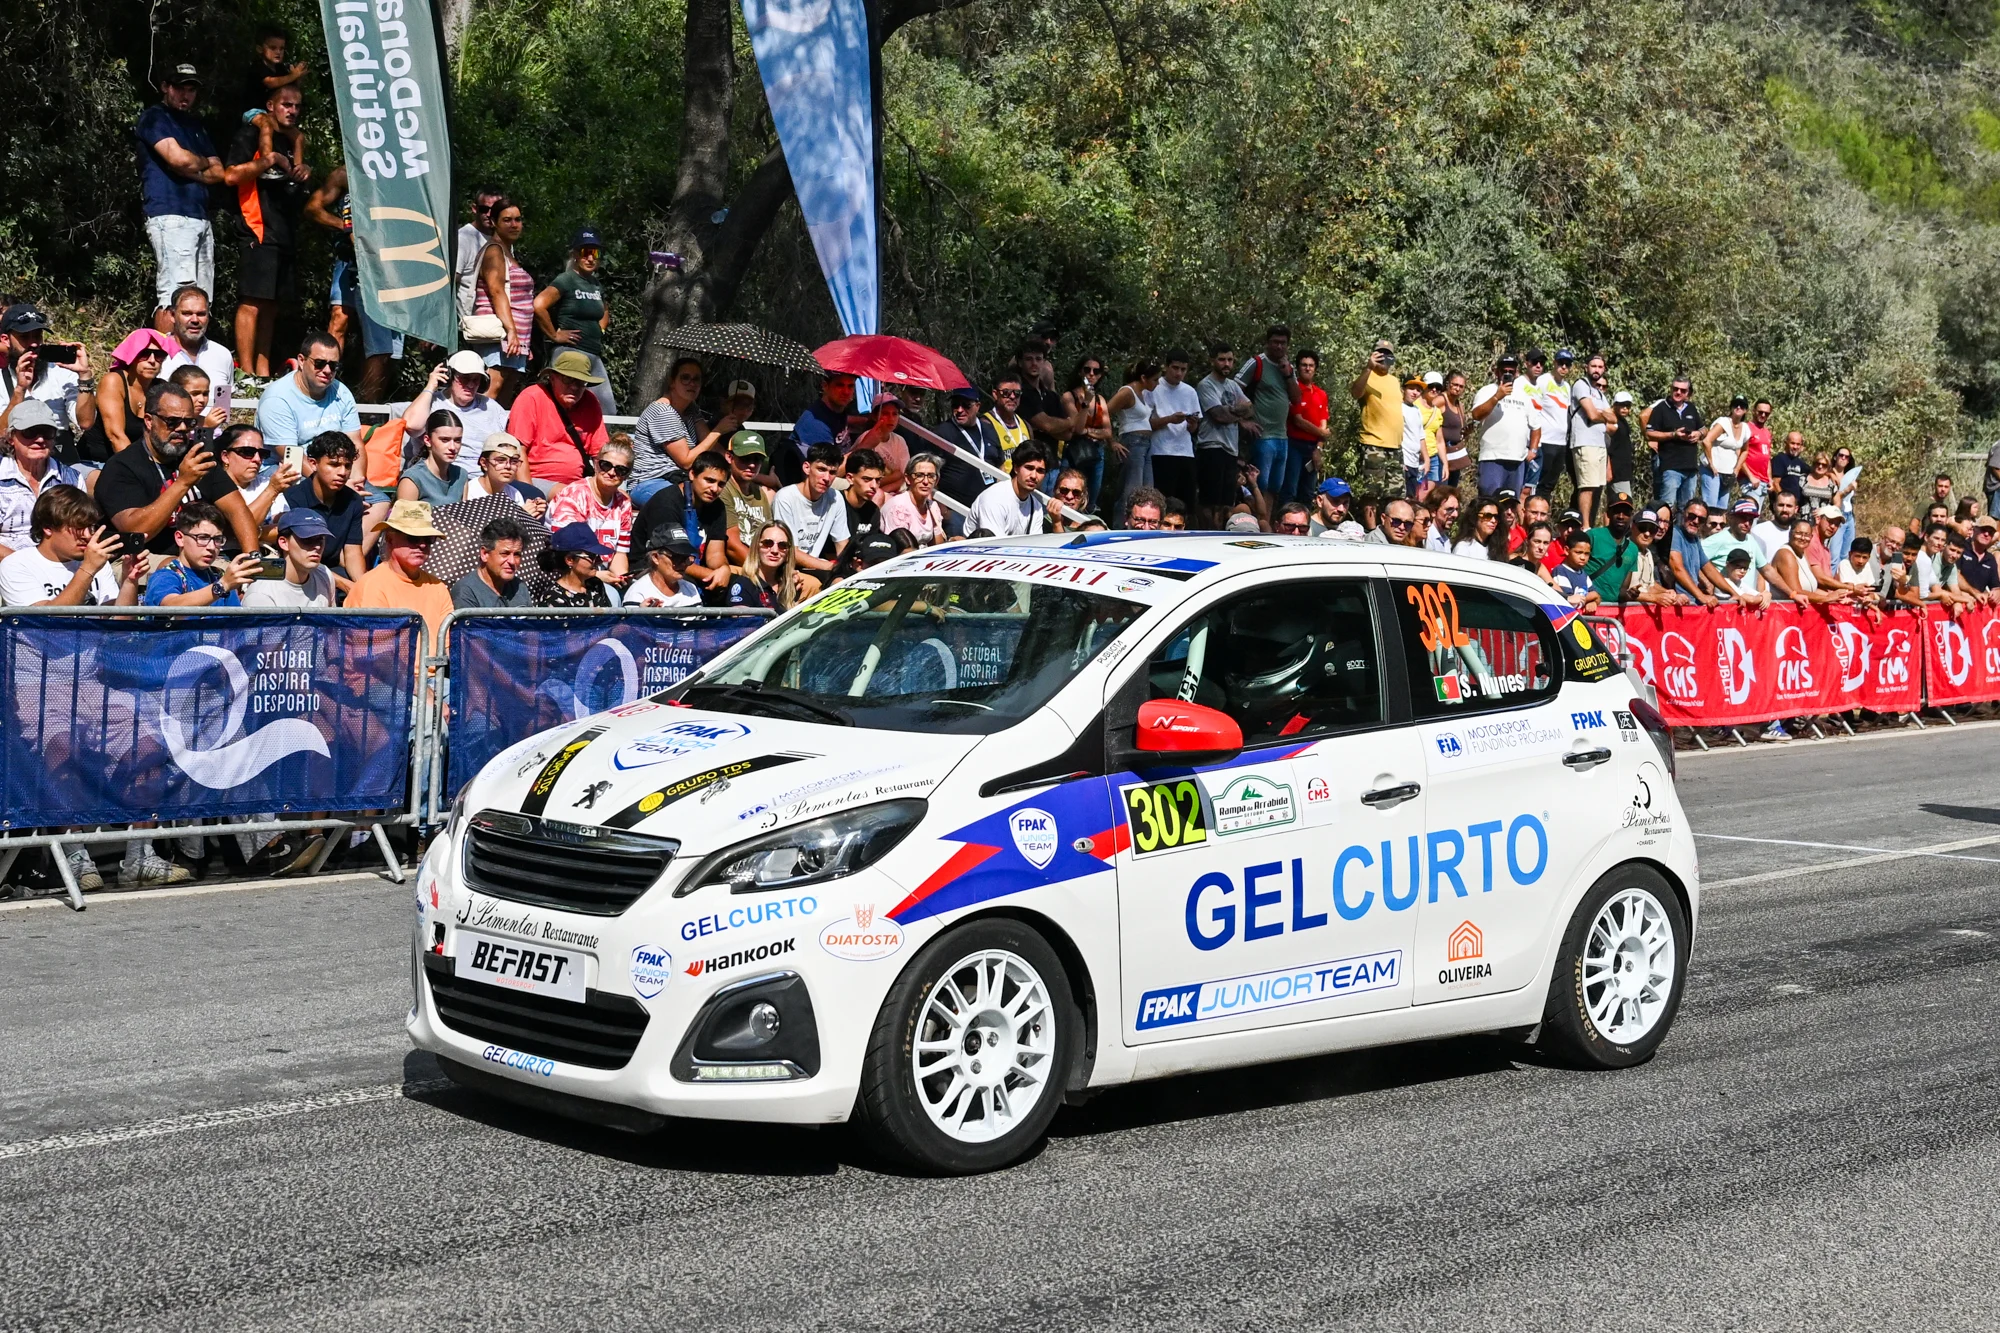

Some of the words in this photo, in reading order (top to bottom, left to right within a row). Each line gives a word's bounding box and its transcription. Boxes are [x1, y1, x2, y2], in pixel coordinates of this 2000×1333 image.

[802, 588, 873, 614] 302
[1407, 582, 1470, 652] 302
[257, 644, 314, 669] SETÚBAL
[645, 642, 693, 665] SETÚBAL
[962, 642, 1002, 662] SETÚBAL
[960, 664, 998, 679] INSPIRA
[1777, 660, 1813, 691] CMS
[254, 672, 311, 692] INSPIRA
[1461, 679, 1477, 699] S.
[1480, 673, 1526, 696] Nunes
[1664, 665, 1699, 699] CMS
[254, 694, 321, 714] DESPORTO
[1468, 719, 1532, 740] MOTORSPORT
[1571, 710, 1607, 731] FPAK
[662, 724, 738, 740] FPAK
[1472, 735, 1517, 754] FUNDING
[1519, 729, 1564, 746] PROGRAM
[627, 742, 692, 757] TEAM
[666, 771, 719, 796] GRUPO
[720, 761, 752, 775] TDS
[875, 778, 935, 797] Restaurante
[1308, 788, 1329, 801] CMS
[1129, 781, 1206, 852] 302
[1219, 806, 1246, 817] Rampa
[1254, 797, 1288, 810] Arrabida
[1018, 818, 1047, 831] FPAK
[1622, 806, 1671, 829] Pimentas
[1018, 834, 1055, 843] JUNIOR
[1023, 842, 1052, 851] TEAM
[472, 898, 539, 937] Pimentas
[542, 921, 599, 949] Restaurante
[826, 934, 898, 946] DIATOSTA
[471, 940, 569, 984] BEFAST
[636, 951, 666, 968] FPAK
[630, 965, 670, 979] JUNIOR
[634, 974, 664, 987] TEAM
[1438, 963, 1492, 985] OLIVEIRA
[496, 977, 537, 991] MOTORSPORT
[1142, 990, 1195, 1021] FPAK
